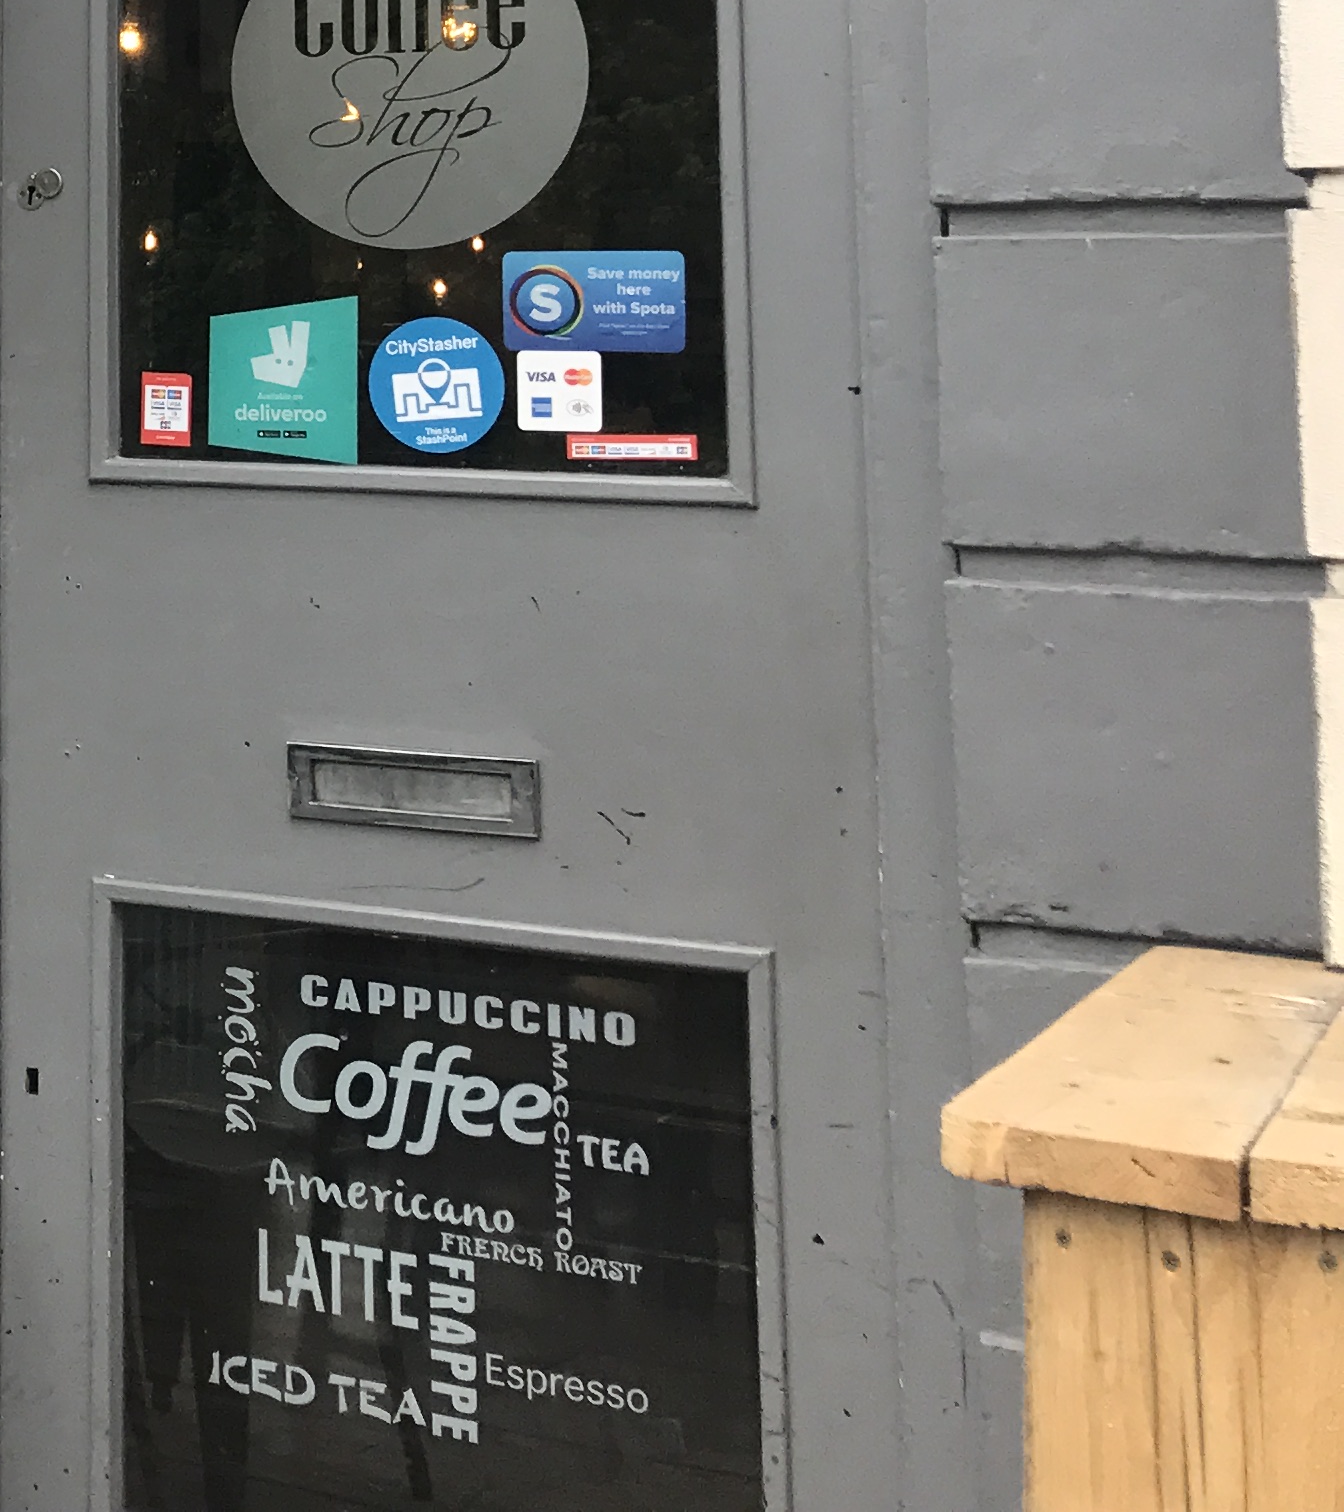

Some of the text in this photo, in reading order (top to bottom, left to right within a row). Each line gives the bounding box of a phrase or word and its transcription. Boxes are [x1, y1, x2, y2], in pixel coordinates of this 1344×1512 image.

[308, 31, 513, 239] Shop
[587, 266, 681, 283] Save money
[616, 282, 652, 296] here
[592, 301, 676, 317] with Spota
[385, 334, 479, 358] CityStasher
[525, 371, 557, 383] VISA
[234, 402, 328, 423] deliveroo
[415, 432, 468, 446] StashPoint
[424, 426, 443, 436] This
[299, 973, 637, 1047] CAPPUCCINO
[215, 965, 273, 1135] mocha
[278, 1031, 554, 1156] Coffee
[550, 1040, 574, 1252] MACCHIATO
[575, 1133, 651, 1176] TEA
[263, 1156, 516, 1235] Americano
[257, 1226, 420, 1331] LATTE
[439, 1230, 643, 1285] FRENCH ROAST
[428, 1252, 480, 1445] FRAPPE
[208, 1349, 428, 1428] ICED TEA
[484, 1351, 650, 1415] Espresso
